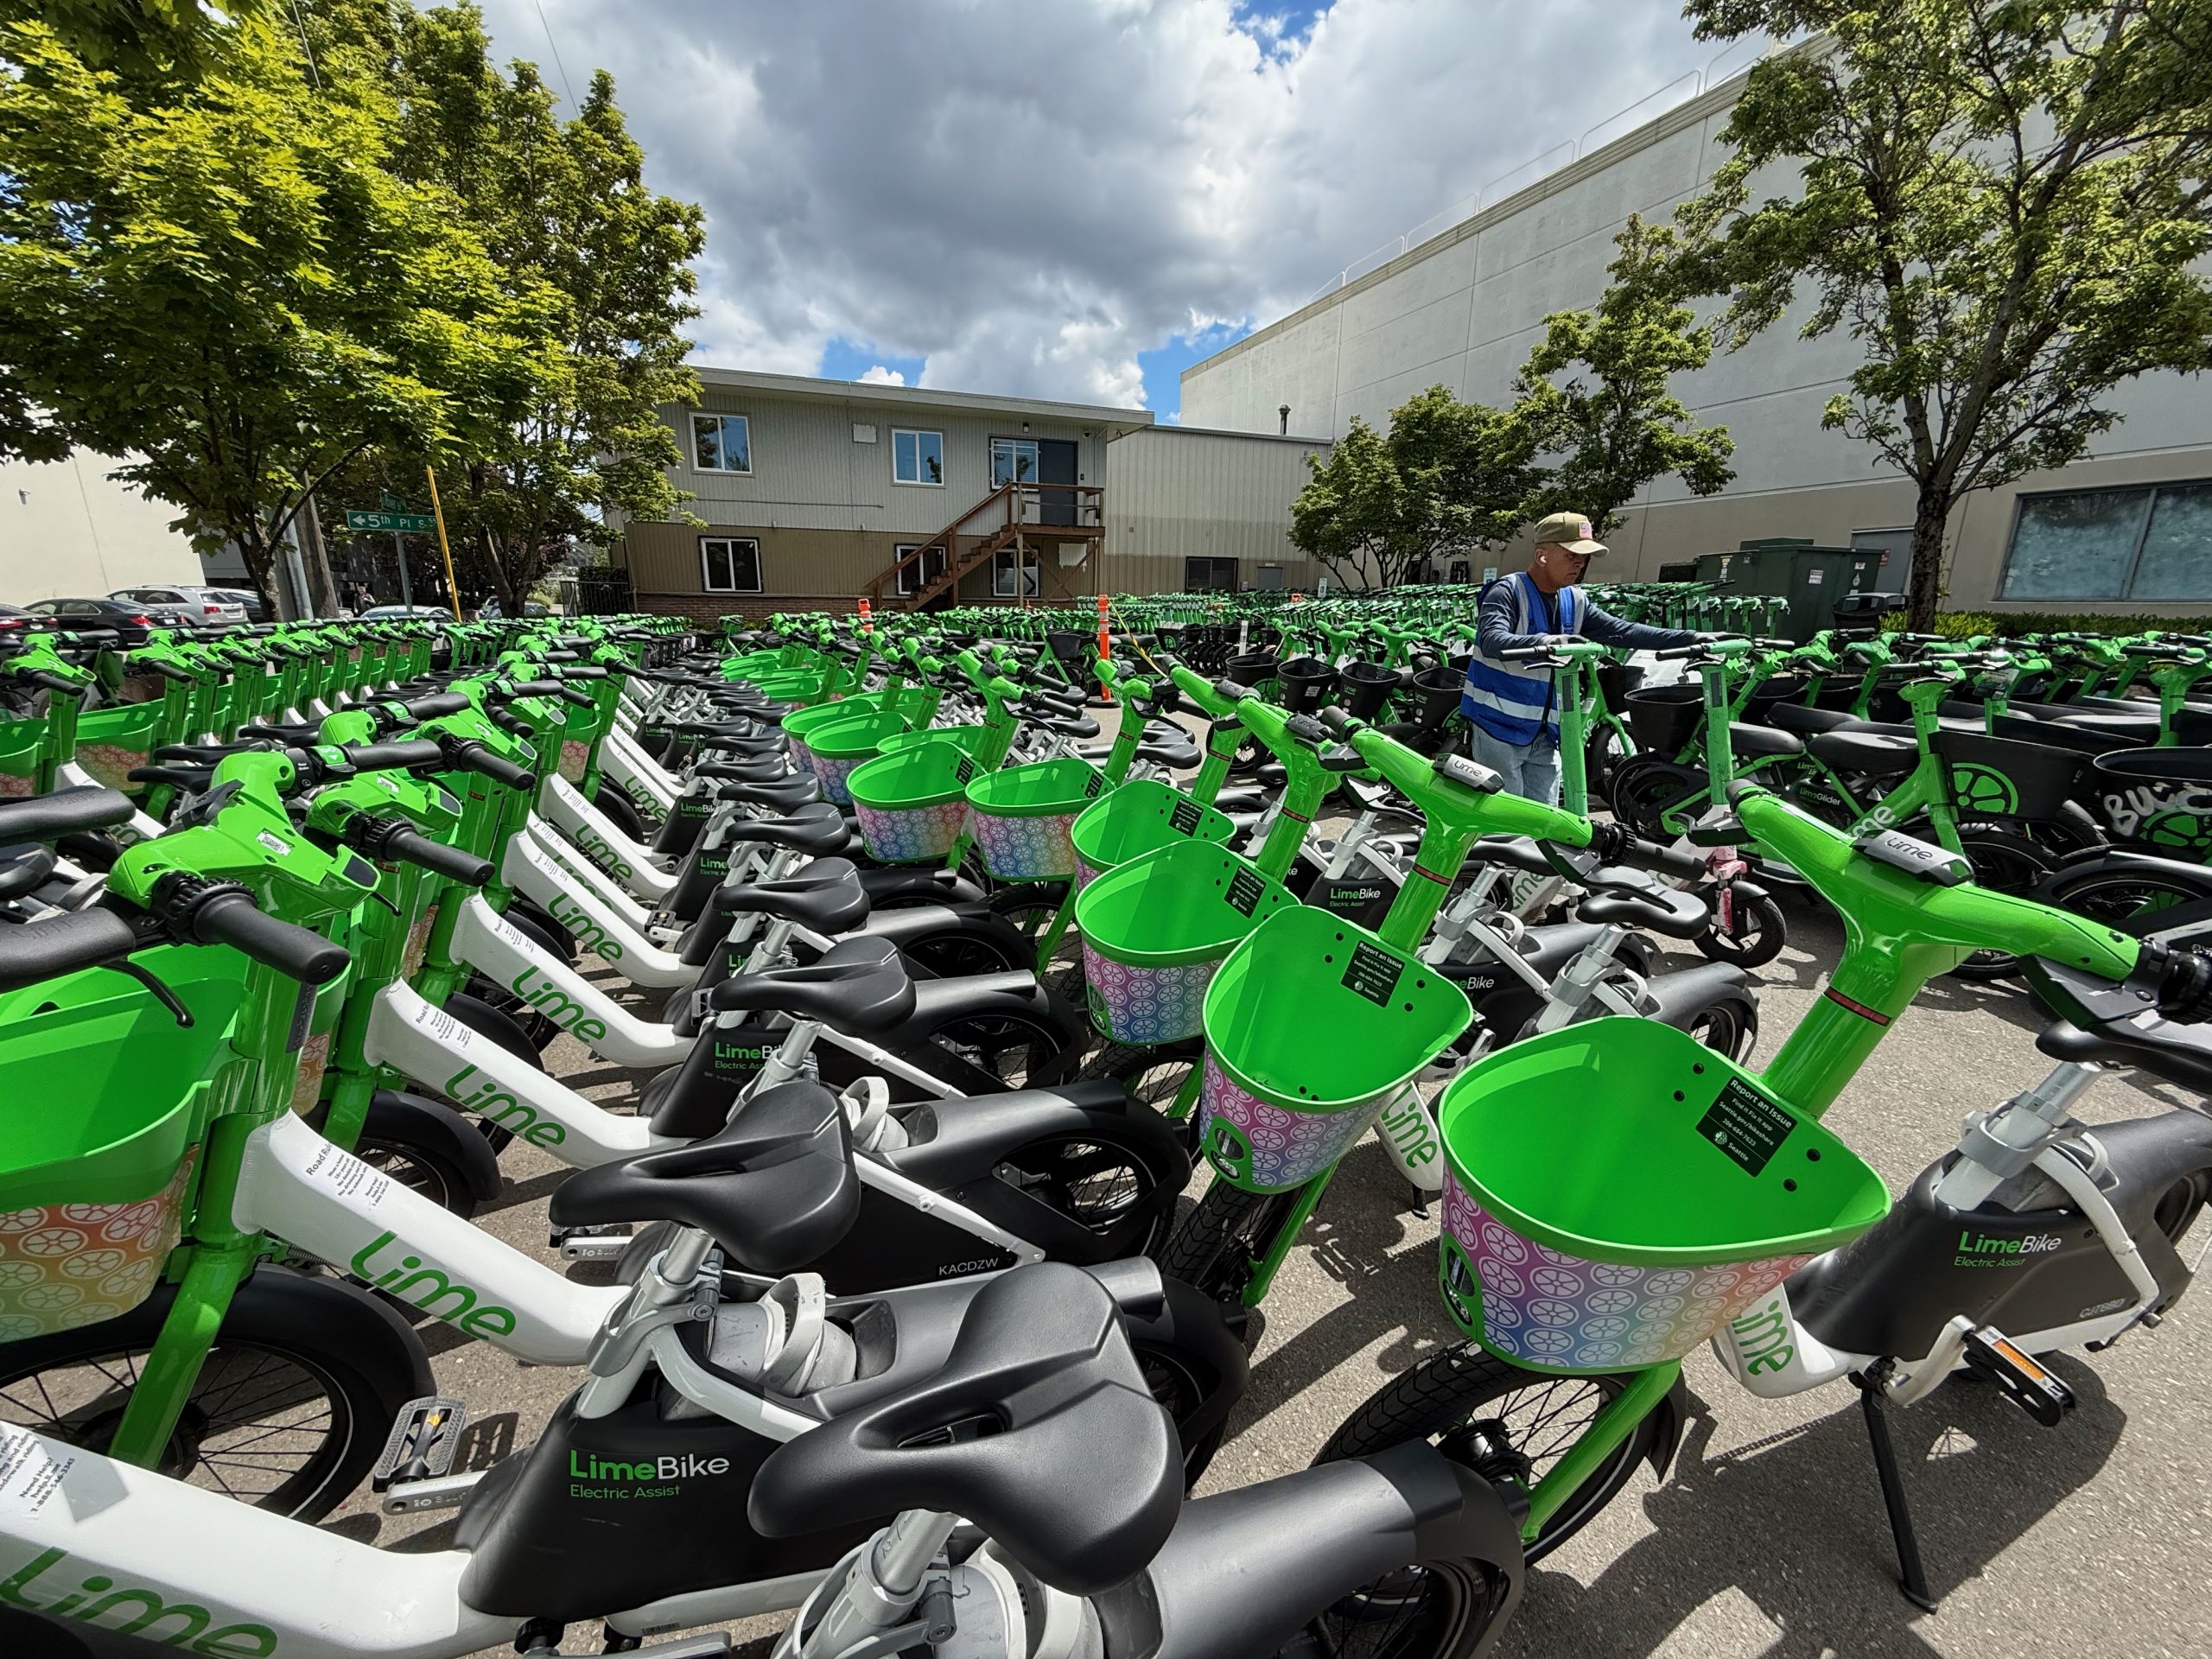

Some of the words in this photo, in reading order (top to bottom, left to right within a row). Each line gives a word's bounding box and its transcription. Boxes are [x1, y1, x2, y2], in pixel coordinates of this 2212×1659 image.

[368, 514, 391, 528] 5th
[399, 518, 410, 528] Pl
[1453, 760, 1483, 778] Lime
[624, 775, 670, 822] Lime
[681, 803, 716, 813] LimeBik
[1799, 787, 1841, 806] LimeGlider
[575, 823, 633, 881] Lime
[1885, 836, 1933, 861] Lime
[1330, 887, 1381, 900] LimeBike
[548, 892, 623, 962] Lime
[1359, 942, 1378, 957] Report
[1387, 957, 1402, 969] Issue
[1452, 976, 1495, 989] eBike
[512, 964, 607, 1043] Lime
[715, 1041, 783, 1059] LimeB
[715, 1060, 747, 1070] Electric
[444, 1063, 567, 1149] Lime
[1731, 1079, 1758, 1103] Report
[1758, 1101, 1769, 1111] an
[1769, 1108, 1792, 1128] Issue
[1732, 1098, 1745, 1109] Find
[1748, 1110, 1757, 1119] Fix
[1762, 1122, 1772, 1131] app
[1381, 1089, 1438, 1170] Lime
[1719, 1101, 1774, 1146] Seattle.gov/bikeshare
[1722, 1118, 1757, 1147] 206-684-7623
[1727, 1142, 1749, 1161] Seattle
[306, 1154, 326, 1175] Road
[1958, 1230, 2063, 1254] LimeBike
[938, 1257, 999, 1276] KACDZW
[1954, 1255, 1996, 1268] Electric
[1996, 1257, 2025, 1267] Assist
[351, 1230, 518, 1342] Lime
[1732, 1300, 1794, 1376] ime
[569, 1449, 731, 1481] LimeBike
[19, 1477, 39, 1498] Need
[569, 1483, 631, 1501] Electric
[633, 1482, 681, 1500] Assist
[0, 1546, 278, 1659] Lime
